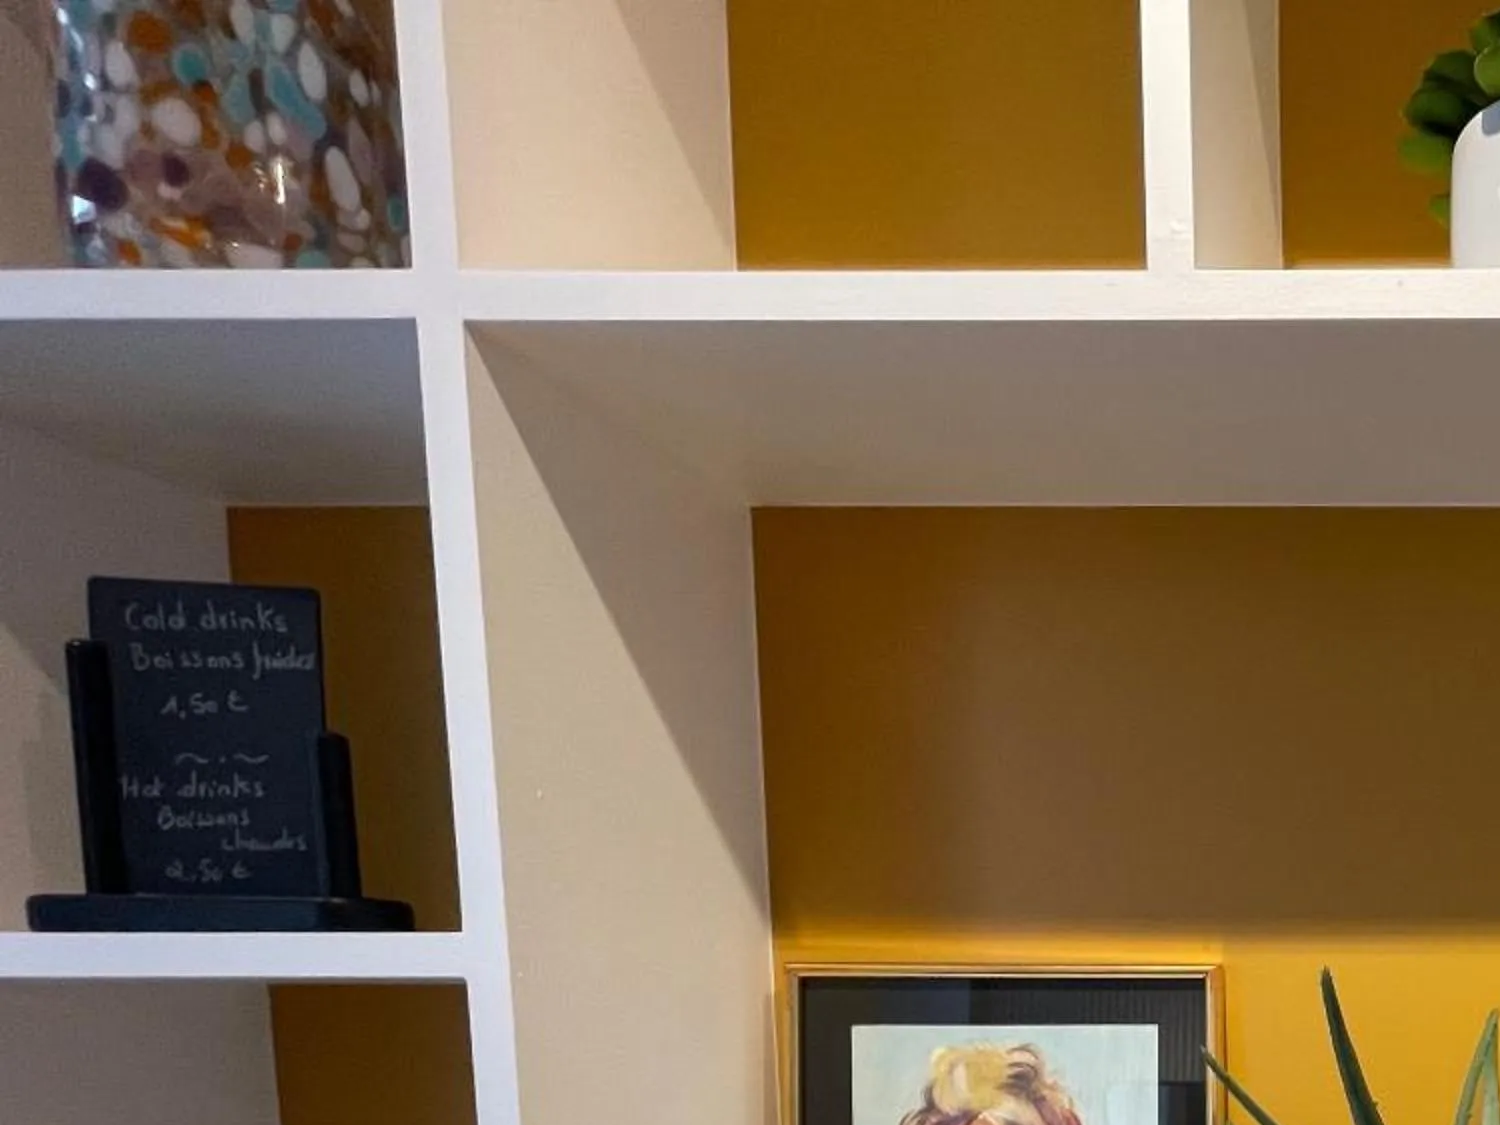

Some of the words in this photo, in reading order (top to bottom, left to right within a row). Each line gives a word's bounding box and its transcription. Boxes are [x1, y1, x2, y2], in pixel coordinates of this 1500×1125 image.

[124, 599, 187, 632] Cold
[199, 599, 289, 633] drinks
[129, 641, 245, 672] Boissons
[119, 771, 164, 801] Hot
[176, 768, 266, 800] drinks
